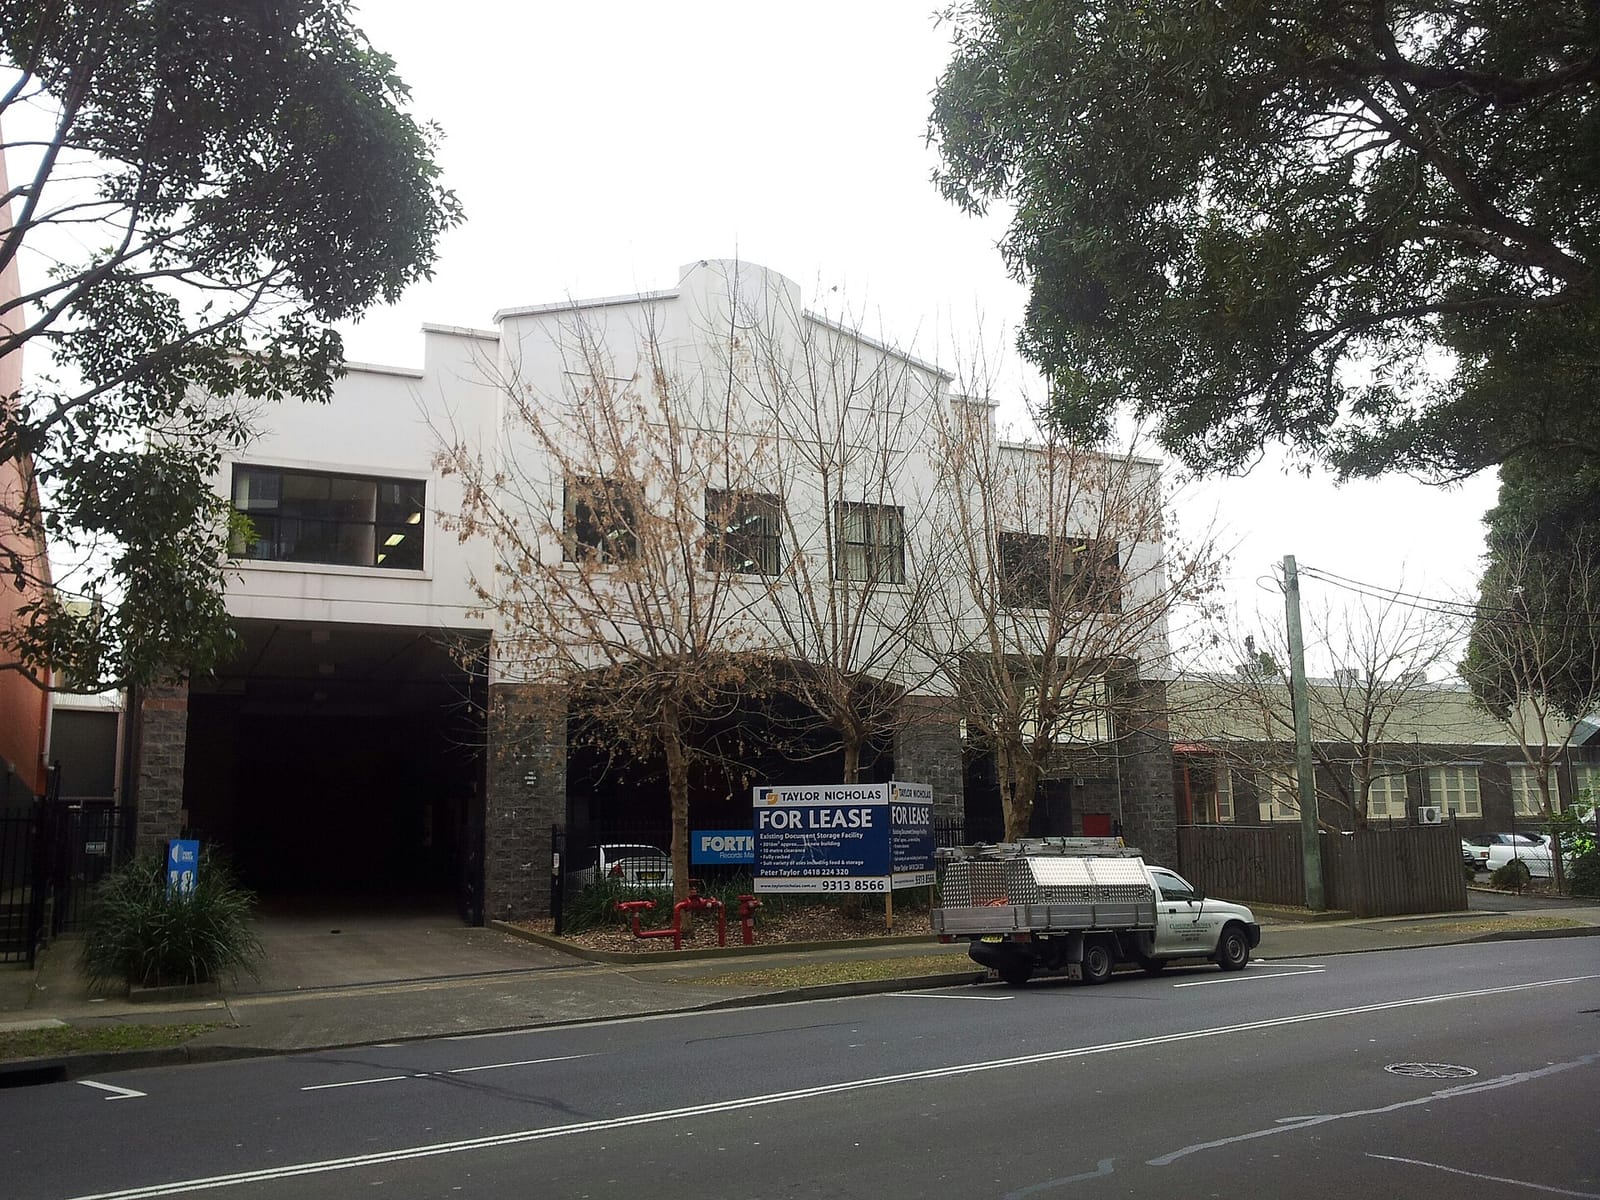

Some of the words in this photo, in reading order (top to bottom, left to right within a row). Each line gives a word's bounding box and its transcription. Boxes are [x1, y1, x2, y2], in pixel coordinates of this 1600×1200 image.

[781, 792, 820, 801] TAYLOR
[825, 790, 881, 800] NICHOLAS
[760, 810, 803, 829] FOR
[809, 809, 873, 829] LEASE
[891, 805, 907, 825] FOR
[908, 807, 929, 825] LEASE
[760, 833, 784, 841] Existing
[785, 832, 816, 840] Document
[817, 832, 840, 840] Storage
[841, 831, 864, 840] Facility
[780, 869, 800, 877] Taylor
[822, 880, 851, 891] 9313
[855, 880, 885, 891] 8566
